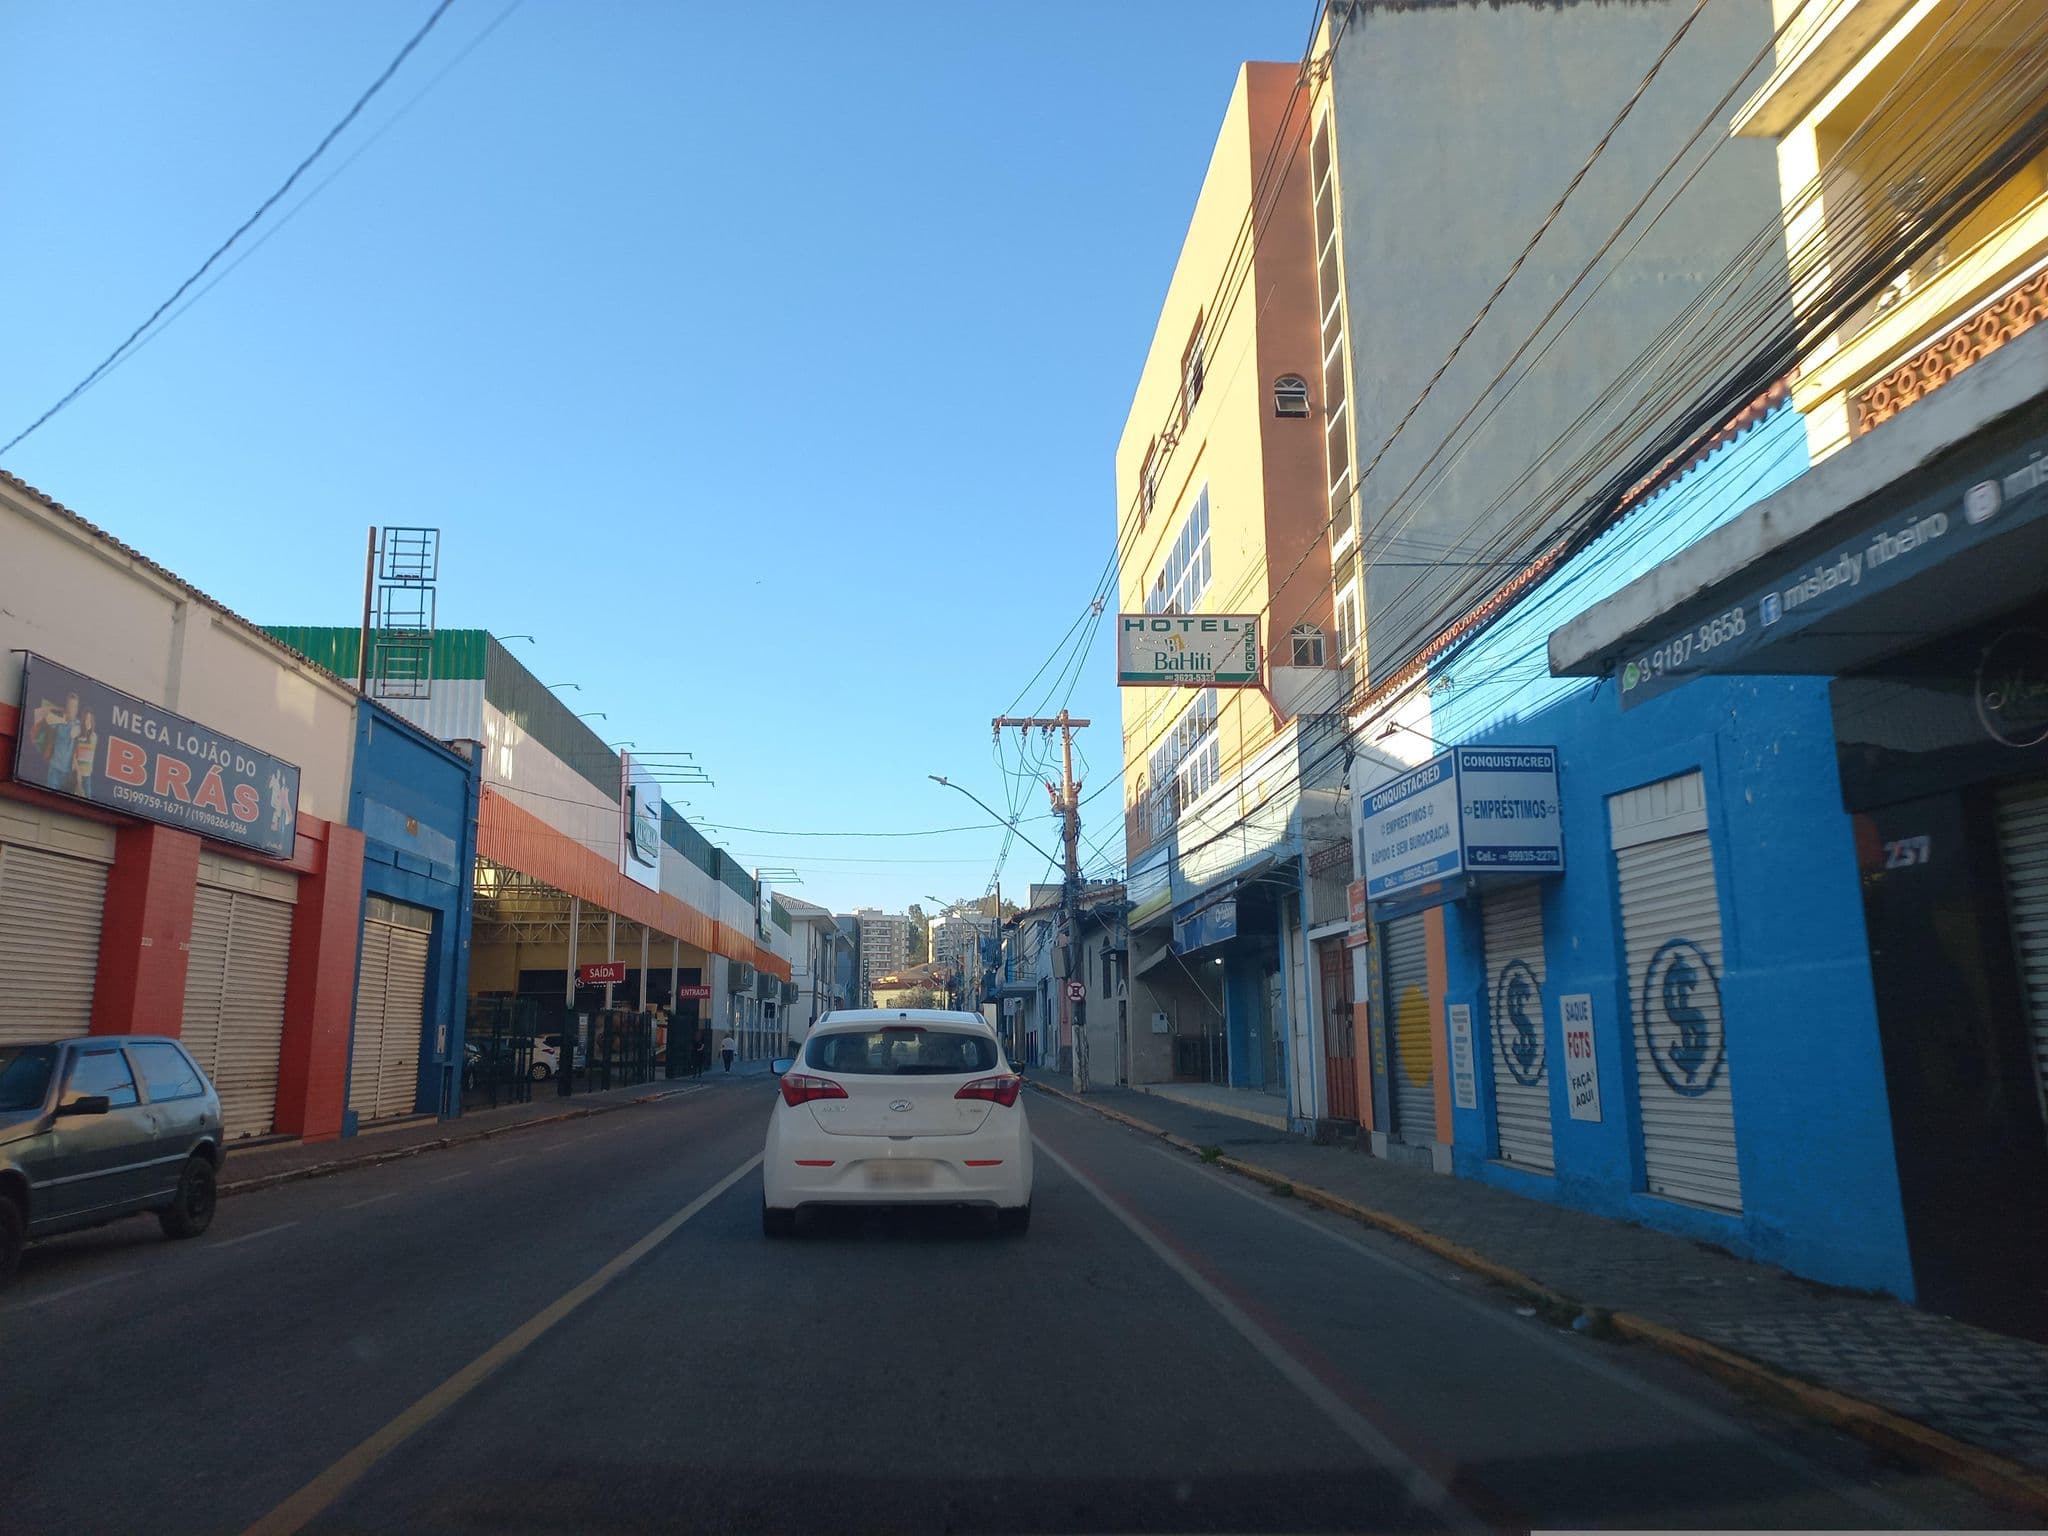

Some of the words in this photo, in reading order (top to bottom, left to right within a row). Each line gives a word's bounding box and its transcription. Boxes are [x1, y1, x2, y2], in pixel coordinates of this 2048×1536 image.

[1652, 607, 1746, 675] 9187-8658
[1784, 552, 1863, 612] mislady
[1866, 512, 1948, 568] ribeiro
[1124, 619, 1240, 632] HOTEL
[112, 705, 170, 746] MEGA
[177, 731, 231, 768] LOJÃO
[236, 755, 257, 777] DO
[1463, 755, 1551, 768] CONQUISTACRED
[105, 735, 260, 823] BRÁS
[1372, 764, 1440, 811] CONQUISTACRED
[1473, 796, 1547, 820] EMPRÉSTIMOS
[1409, 823, 1450, 851] BUROCRACIA
[589, 965, 615, 978] SAÍDA
[681, 988, 709, 997] ENTRADA
[1565, 1000, 1588, 1022] SAQUE
[1567, 1031, 1592, 1059] FGTS
[1575, 1089, 1595, 1108] AQUI
